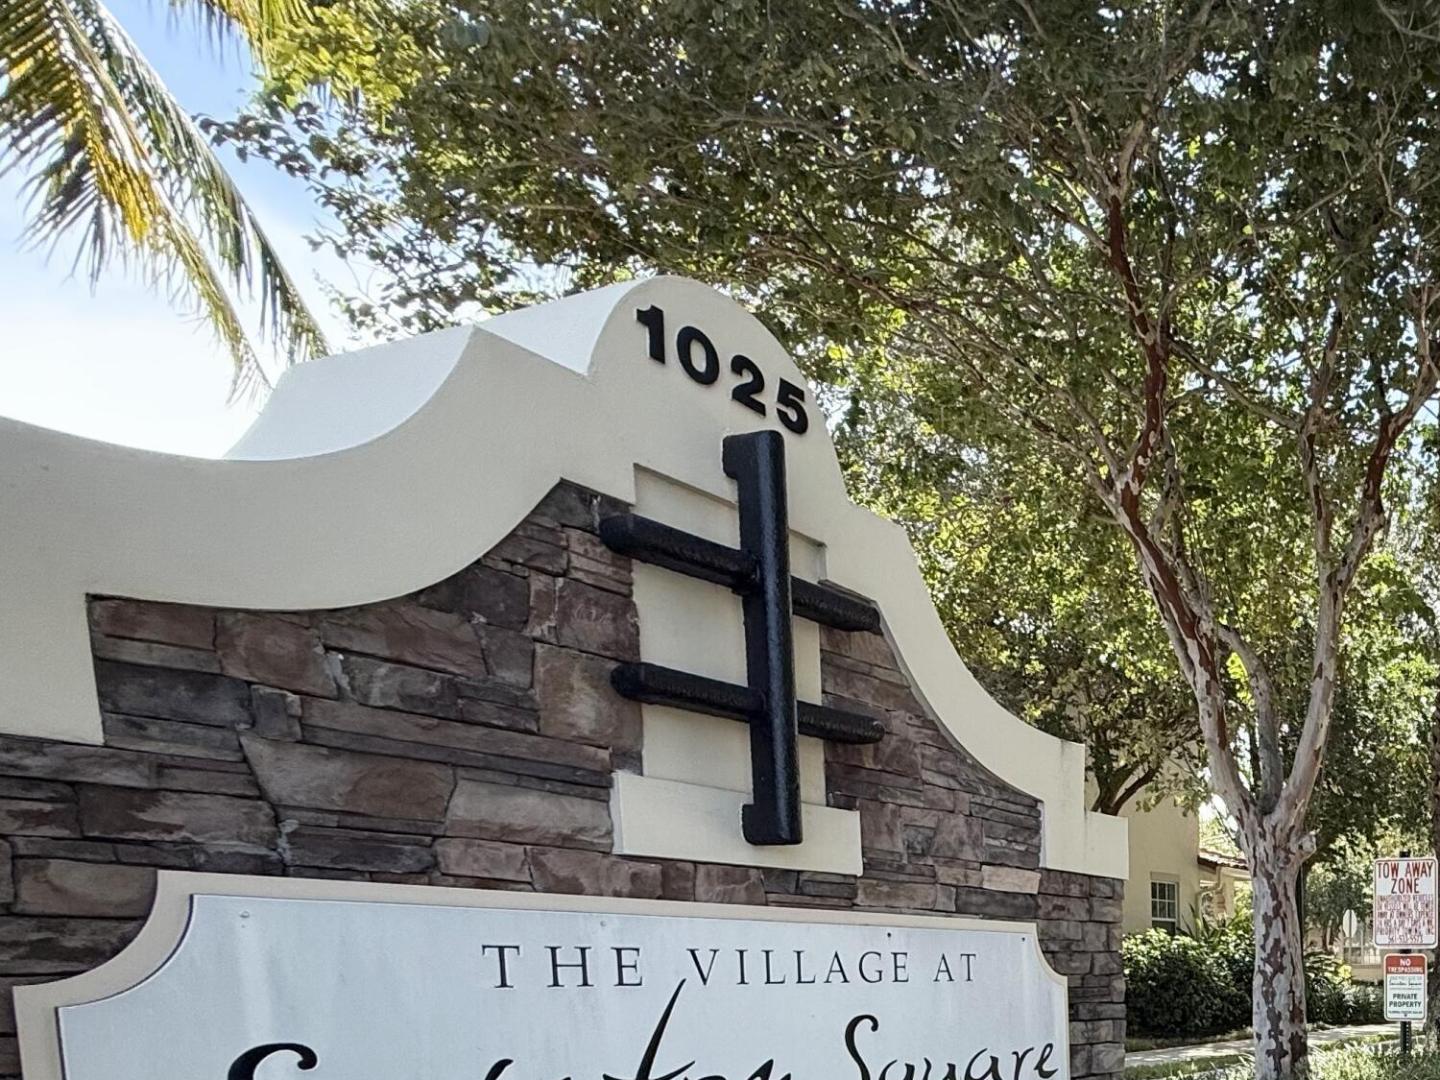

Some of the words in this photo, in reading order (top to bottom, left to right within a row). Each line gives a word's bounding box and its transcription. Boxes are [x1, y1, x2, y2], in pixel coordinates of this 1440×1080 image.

[636, 304, 809, 435] 1025
[1377, 862, 1399, 878] TOW
[1405, 862, 1434, 877] AWAY
[1391, 878, 1420, 894] ZONE
[482, 945, 644, 989] THE
[686, 948, 910, 987] VILLAGE
[932, 953, 977, 983] AT
[1399, 958, 1411, 966] NO
